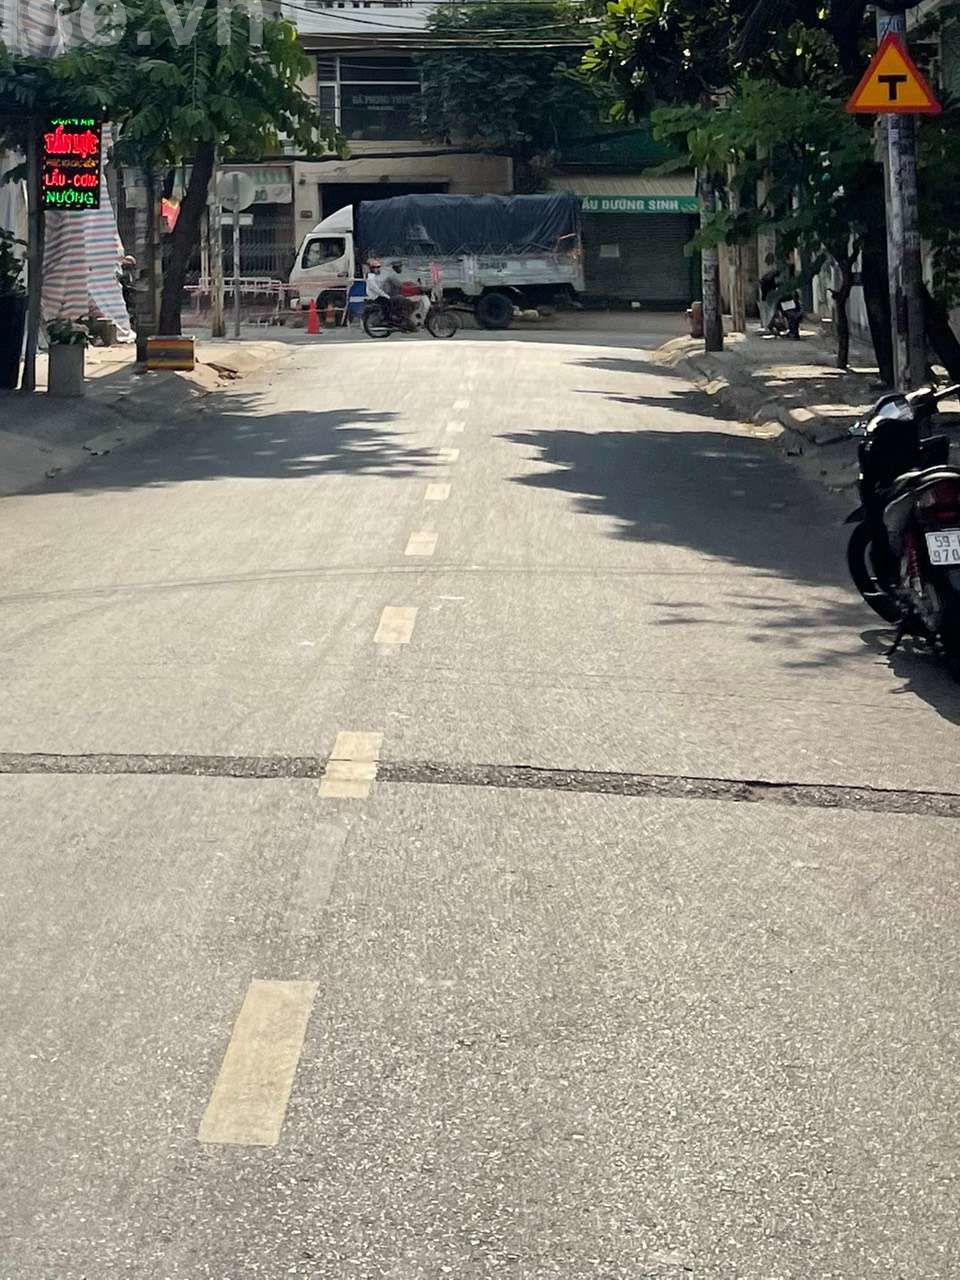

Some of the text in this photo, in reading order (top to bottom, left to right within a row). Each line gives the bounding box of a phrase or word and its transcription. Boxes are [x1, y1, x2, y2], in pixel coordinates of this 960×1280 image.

[45, 169, 66, 186] LẨU
[74, 173, 97, 187] CƠM
[46, 188, 94, 204] NƯỚNG
[648, 199, 678, 210] SINH
